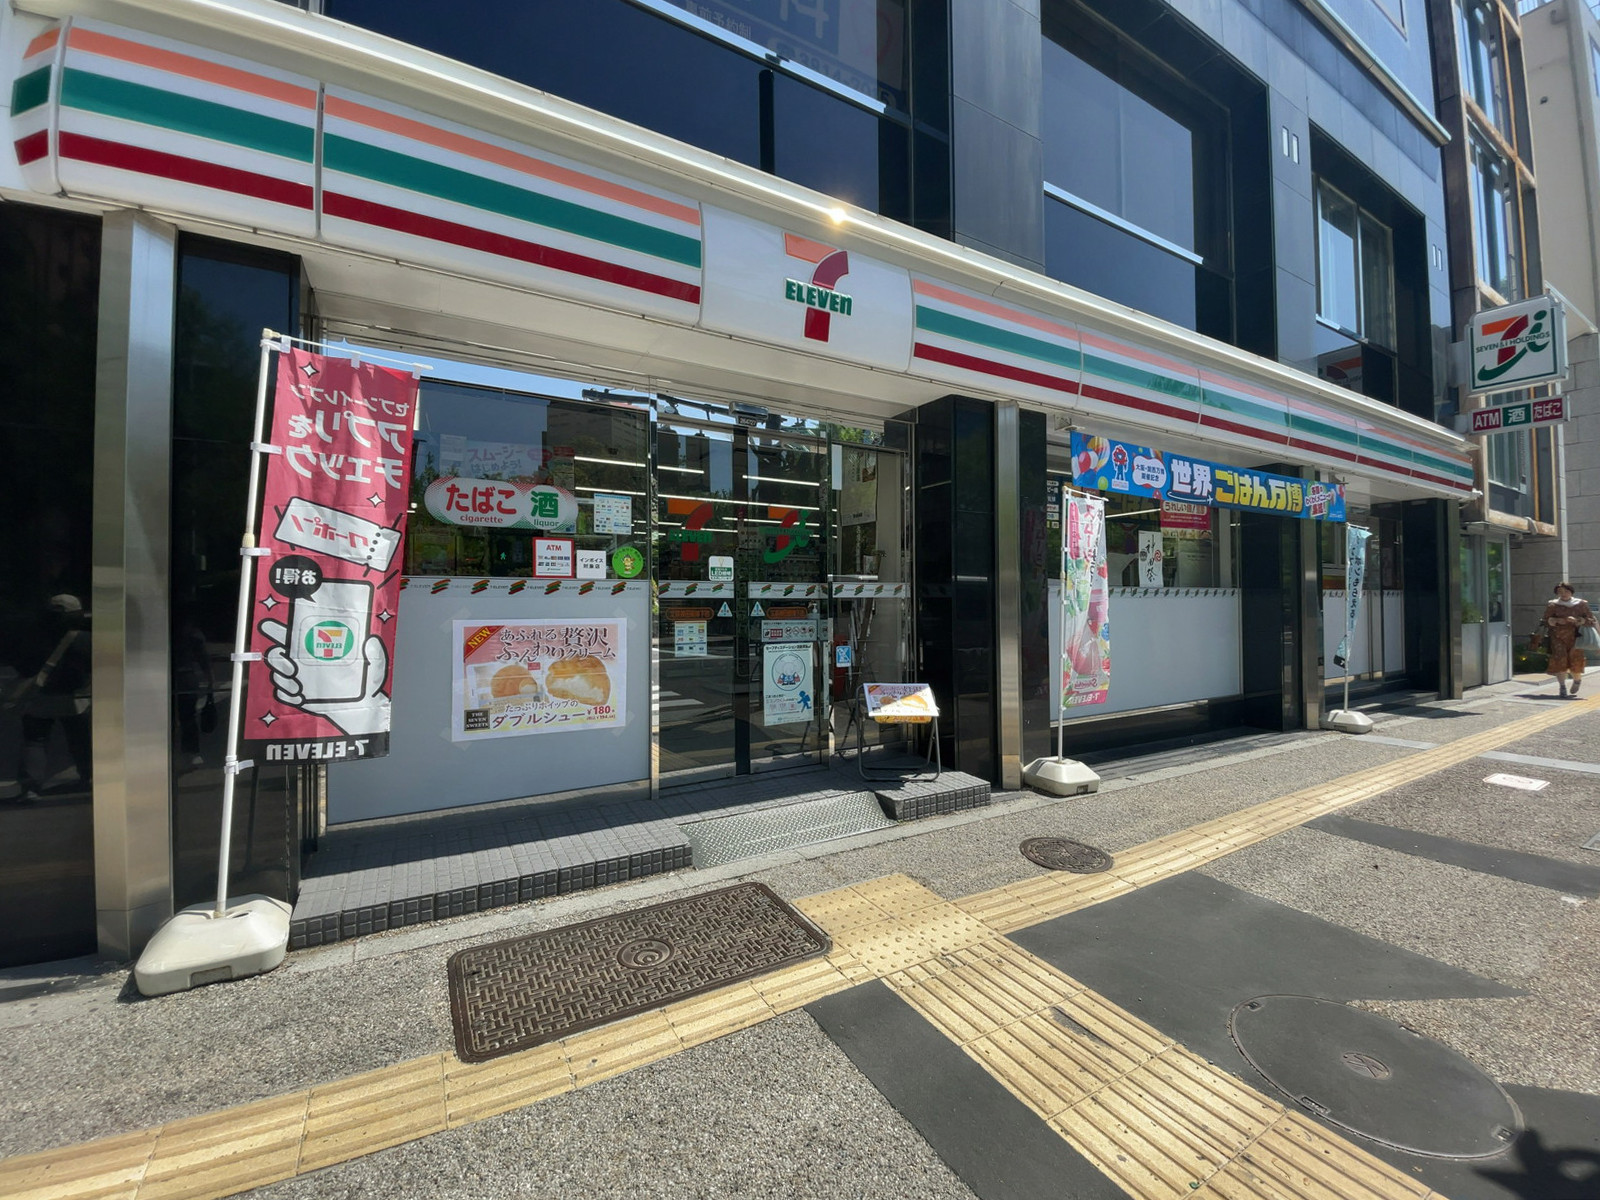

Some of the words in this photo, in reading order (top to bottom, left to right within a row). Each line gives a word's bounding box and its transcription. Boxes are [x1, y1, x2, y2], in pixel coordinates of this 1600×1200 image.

[1475, 342, 1499, 354] SEVEN
[1510, 331, 1551, 345] HOLDINGS
[1507, 406, 1527, 424] 酒
[1534, 401, 1562, 419] たばこ
[1474, 412, 1500, 429] ATM
[446, 484, 517, 515] たばこ
[530, 491, 559, 519] 酒
[460, 514, 504, 524] cigarette
[533, 518, 559, 528] liquor
[468, 627, 492, 649] NEW
[496, 643, 616, 663] ふんわりクリーム
[505, 700, 579, 713] たっぷりホイップの
[492, 710, 585, 729] ダブルシュー
